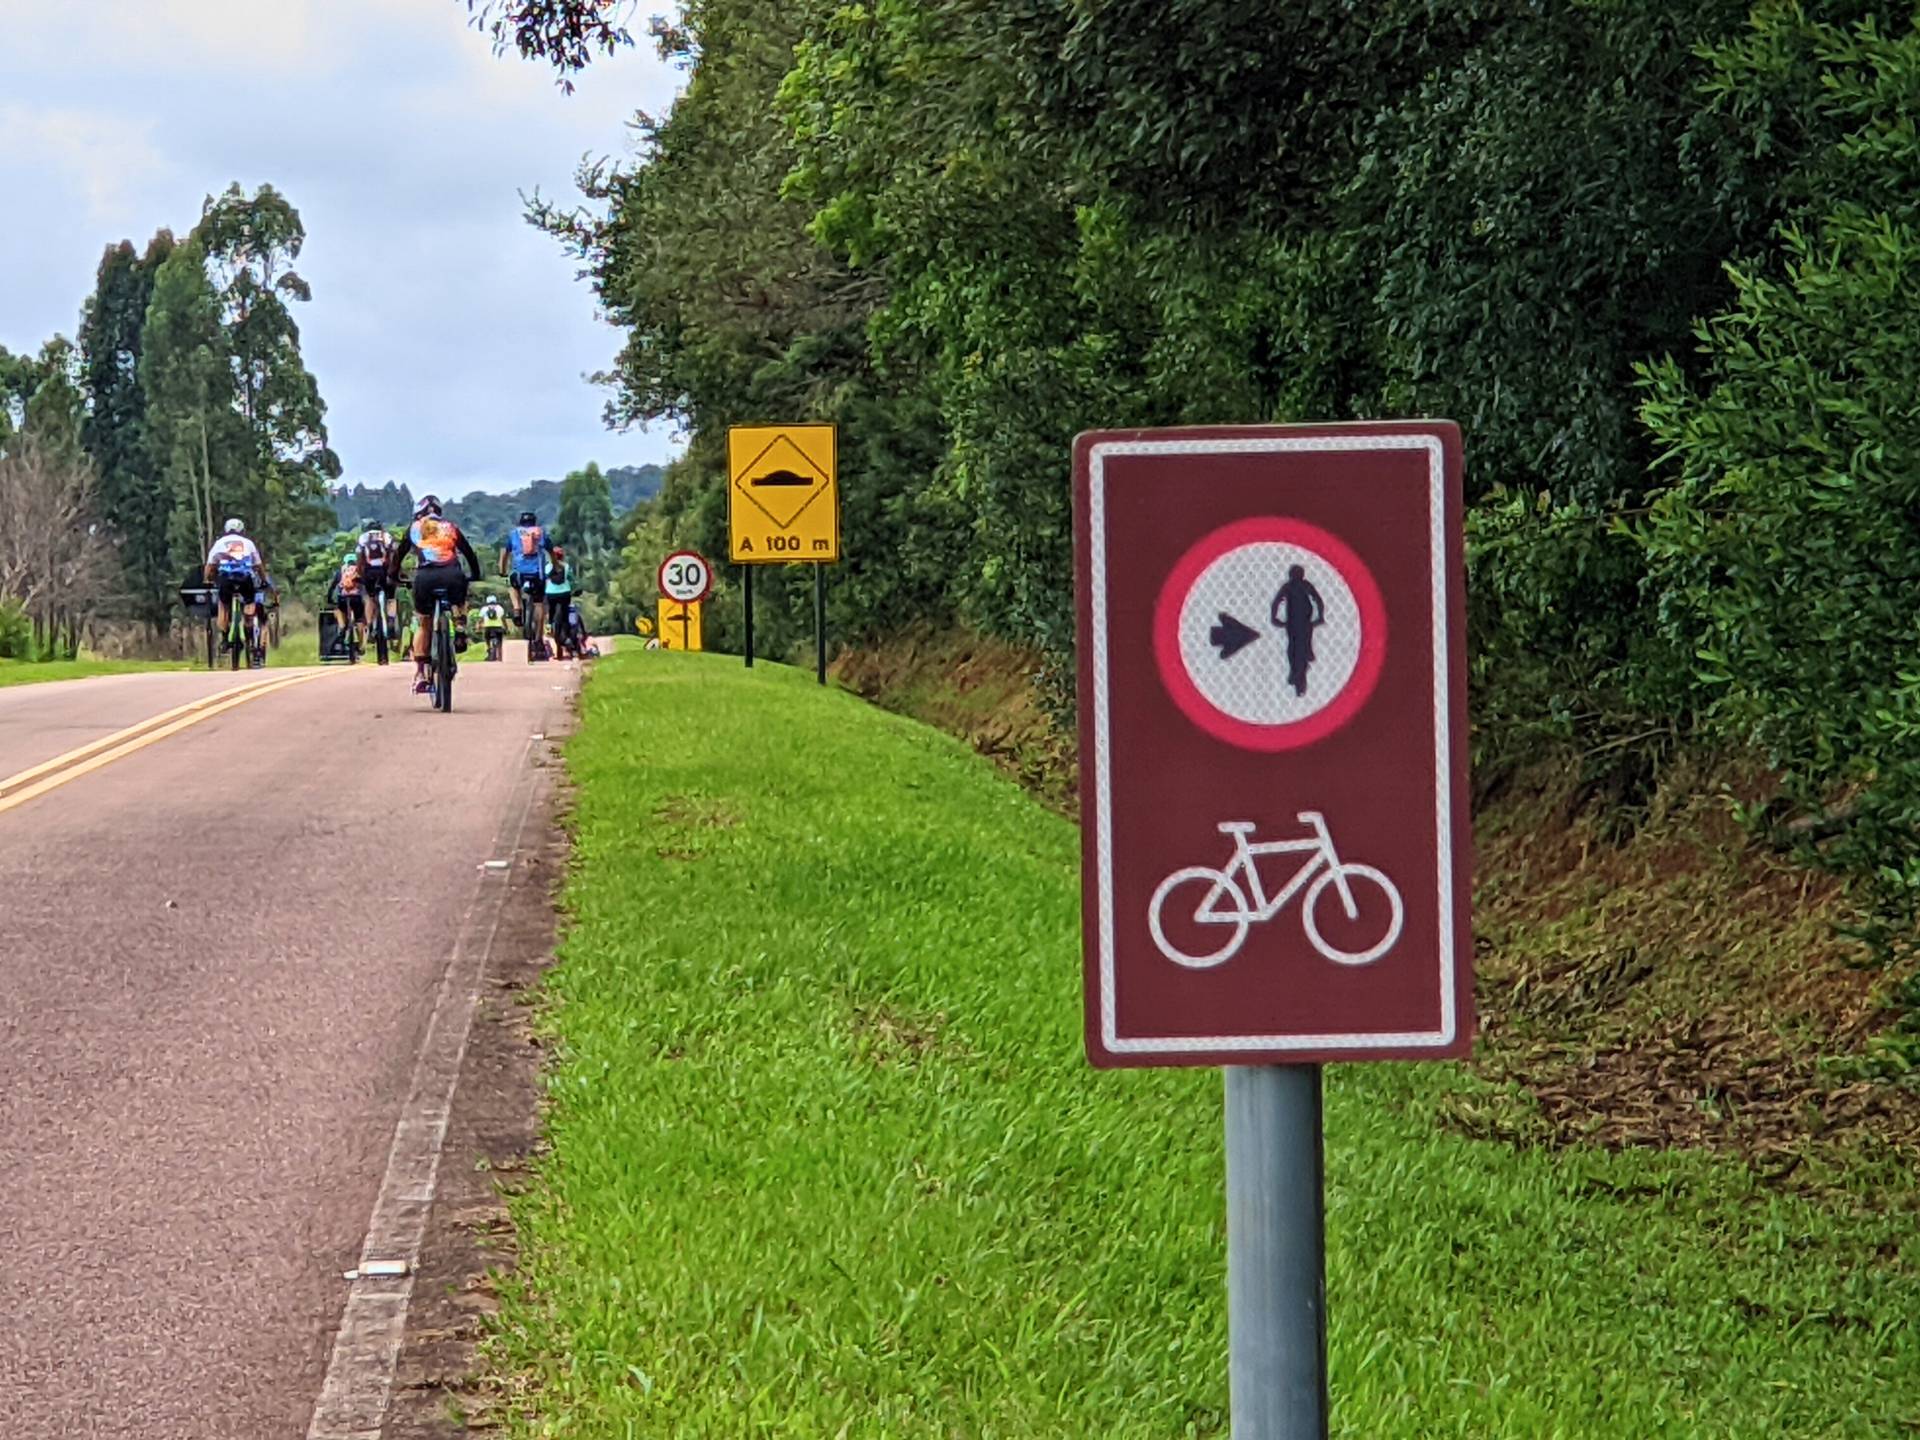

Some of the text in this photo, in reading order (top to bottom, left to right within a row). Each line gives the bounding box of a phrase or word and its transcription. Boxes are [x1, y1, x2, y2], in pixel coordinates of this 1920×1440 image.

[739, 536, 829, 552] A 100 m
[668, 563, 700, 585] 30
